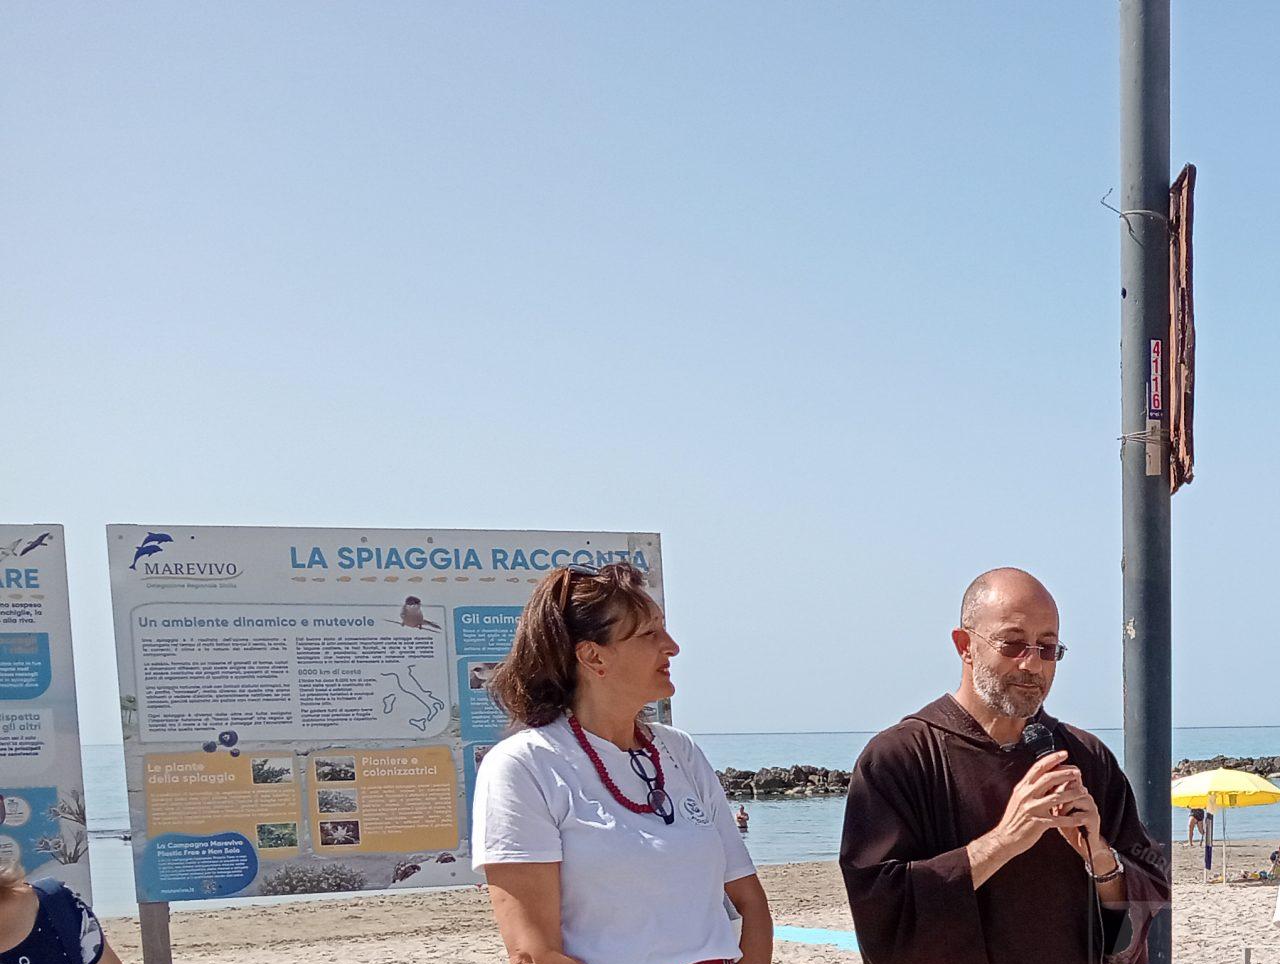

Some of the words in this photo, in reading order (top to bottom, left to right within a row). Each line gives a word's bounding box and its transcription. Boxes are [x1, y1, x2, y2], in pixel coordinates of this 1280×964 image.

[1152, 341, 1161, 409] 4116
[291, 547, 329, 569] LA
[337, 547, 483, 570] SPIAGGIA
[492, 548, 650, 573] RACCONTA
[144, 562, 237, 576] MAREVIVO
[138, 616, 158, 628] Un
[161, 616, 229, 628] ambiente
[233, 616, 297, 628] dinamico
[300, 618, 309, 628] e
[313, 616, 375, 627] mutevole
[461, 613, 480, 624] Gli
[2, 722, 16, 733] gli
[19, 722, 41, 731] altri
[361, 756, 408, 766] Pioniere
[147, 763, 162, 773] Le
[164, 762, 205, 775] piante
[362, 765, 438, 777] colonizzatrici
[148, 773, 180, 784] della
[182, 772, 236, 785] spiaggia
